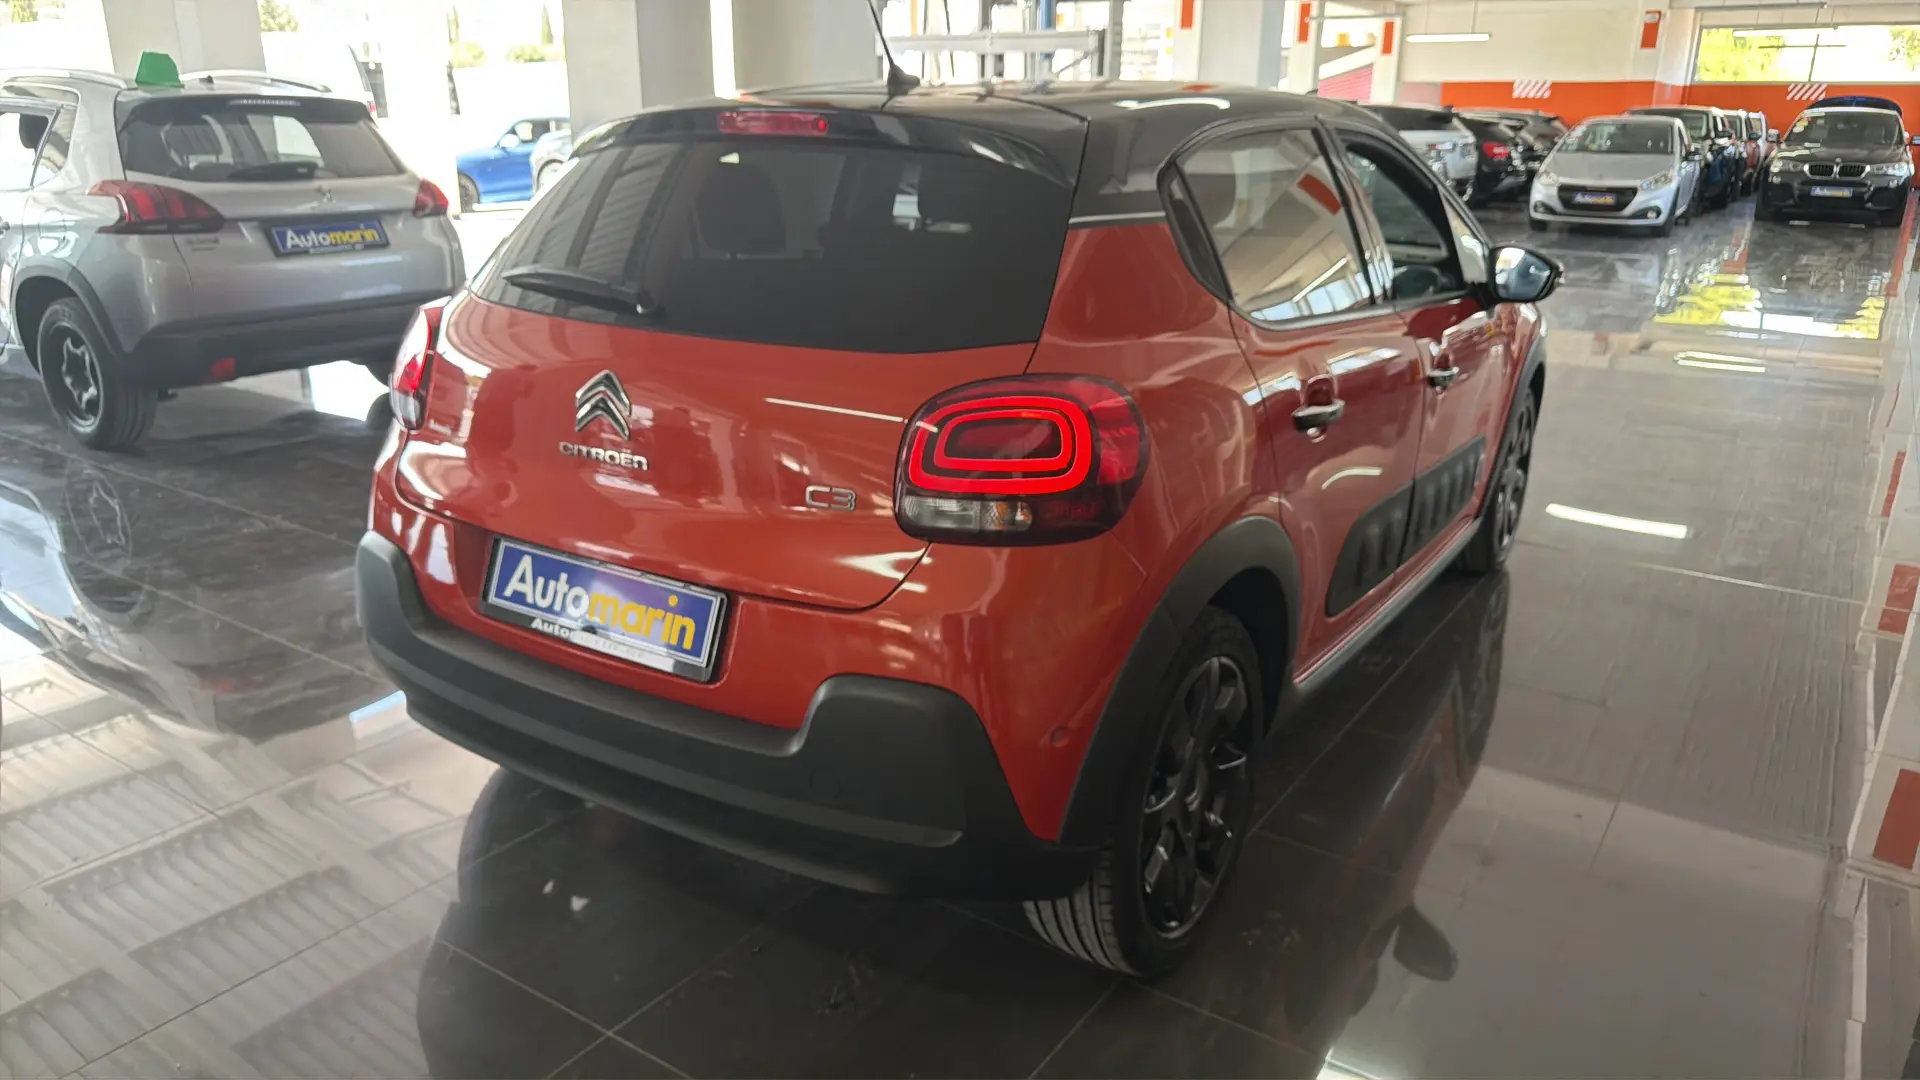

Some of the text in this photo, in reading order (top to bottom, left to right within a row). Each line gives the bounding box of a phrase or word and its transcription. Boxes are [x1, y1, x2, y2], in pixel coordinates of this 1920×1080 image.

[286, 223, 380, 249] Automarin
[805, 485, 857, 511] C3
[503, 554, 696, 650] Automarin
